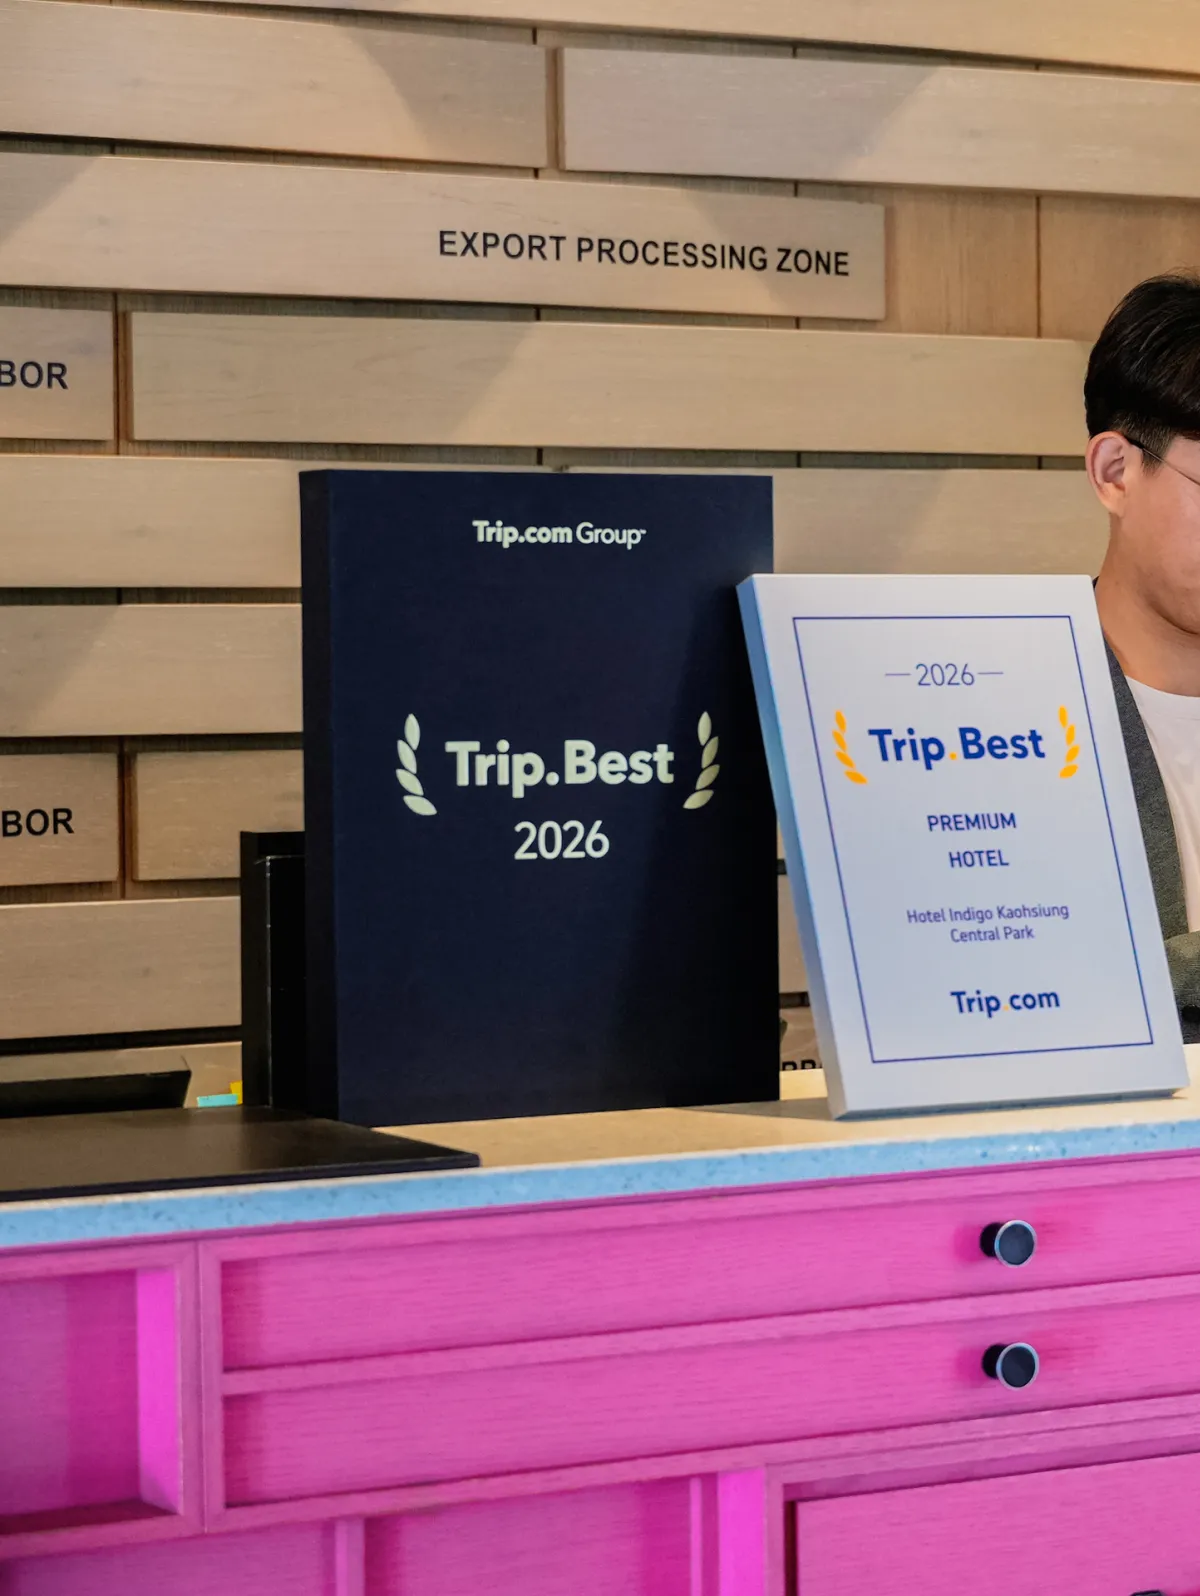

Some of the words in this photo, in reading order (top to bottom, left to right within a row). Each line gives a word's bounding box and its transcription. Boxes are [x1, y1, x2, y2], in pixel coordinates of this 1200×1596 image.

[439, 230, 567, 261] EXPORT
[577, 236, 768, 272] PROCESSING
[776, 247, 849, 277] ZONE
[472, 520, 573, 549] Trip.com
[915, 662, 976, 687] 2026
[868, 726, 1046, 771] Trip.Best
[445, 739, 675, 797] Trip.Best
[1, 807, 75, 838] BOR
[926, 812, 1017, 832] PREMIUM
[514, 819, 610, 860] 2026
[948, 849, 1010, 868] HOTEL
[906, 908, 947, 924] Hotel
[949, 906, 994, 924] Indigo
[996, 903, 1070, 920] Kaohsiung
[950, 927, 1000, 943] Central
[1003, 924, 1035, 940] Park
